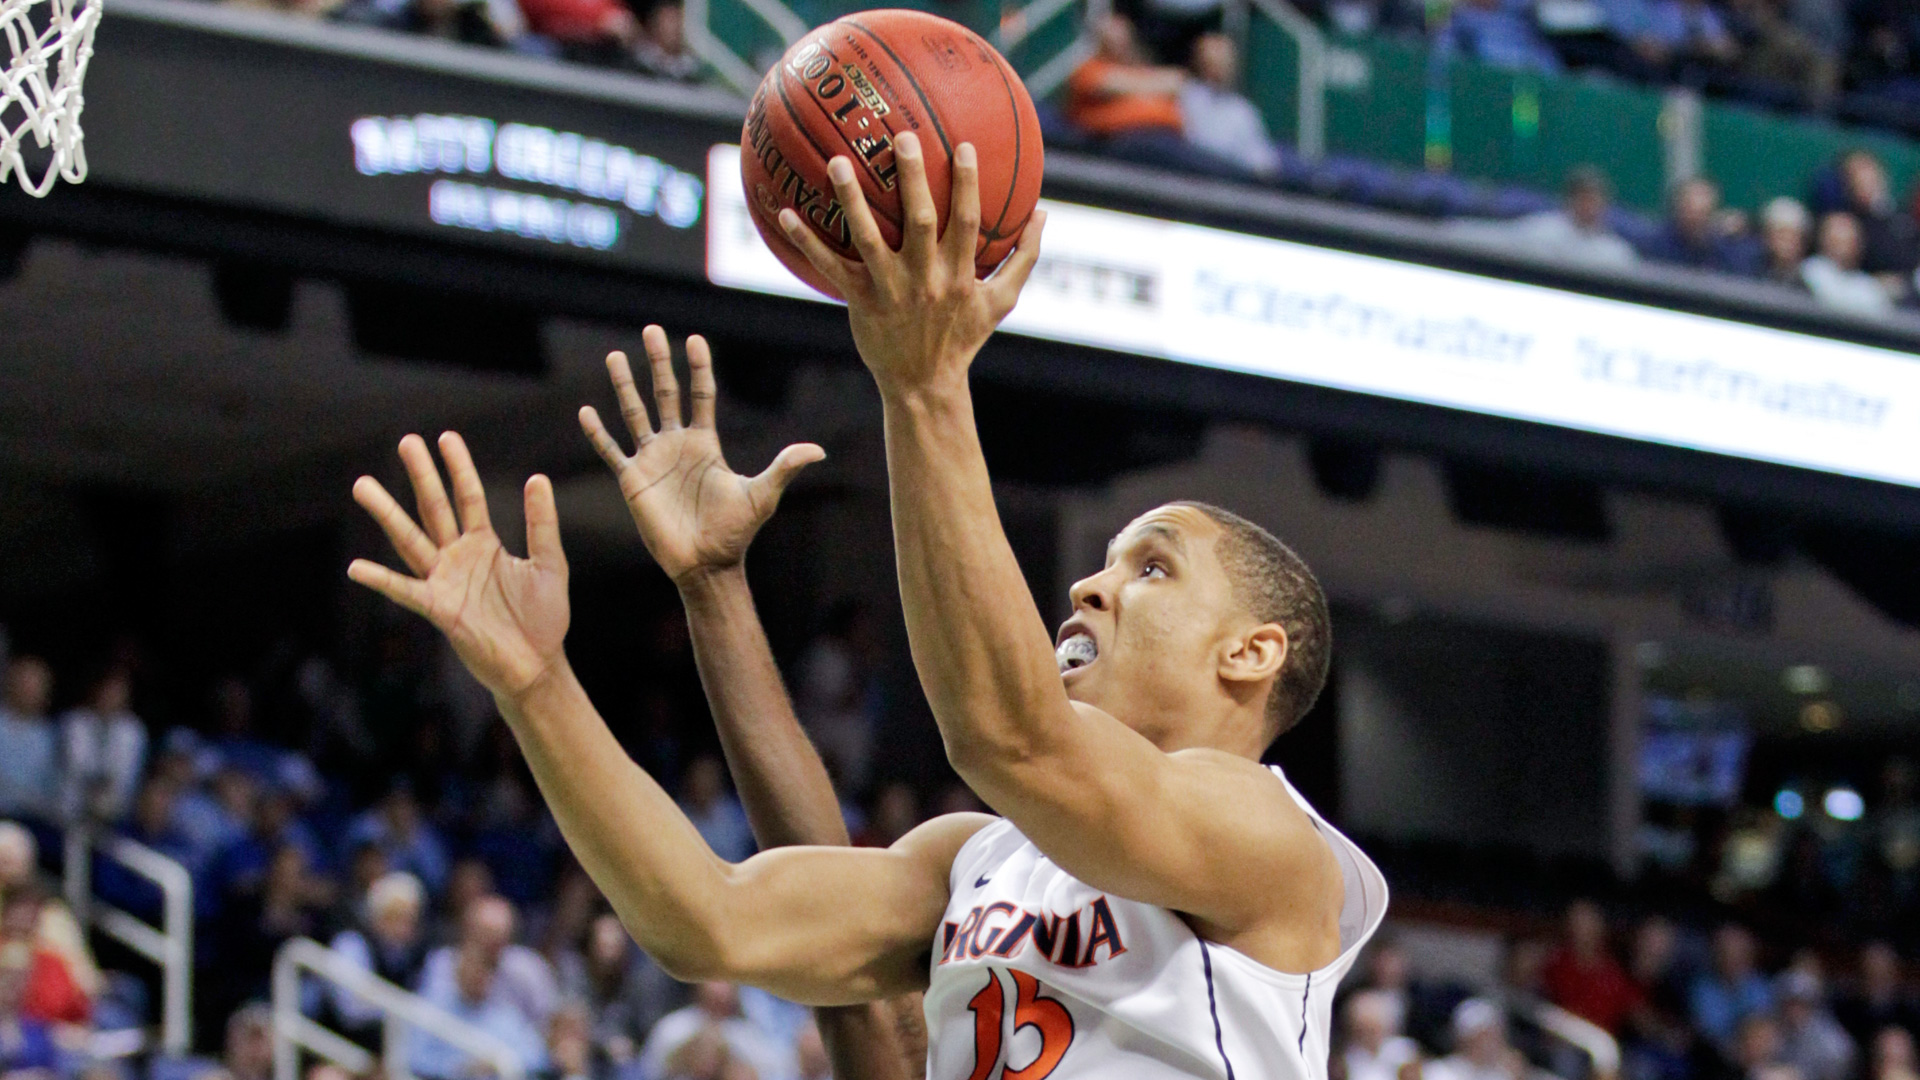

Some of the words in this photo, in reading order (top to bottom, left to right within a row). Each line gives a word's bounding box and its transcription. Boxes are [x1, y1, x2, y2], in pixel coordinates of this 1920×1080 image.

[793, 42, 898, 191] TF-1000
[842, 62, 891, 119] LEGACY
[966, 966, 1076, 1080] 15
